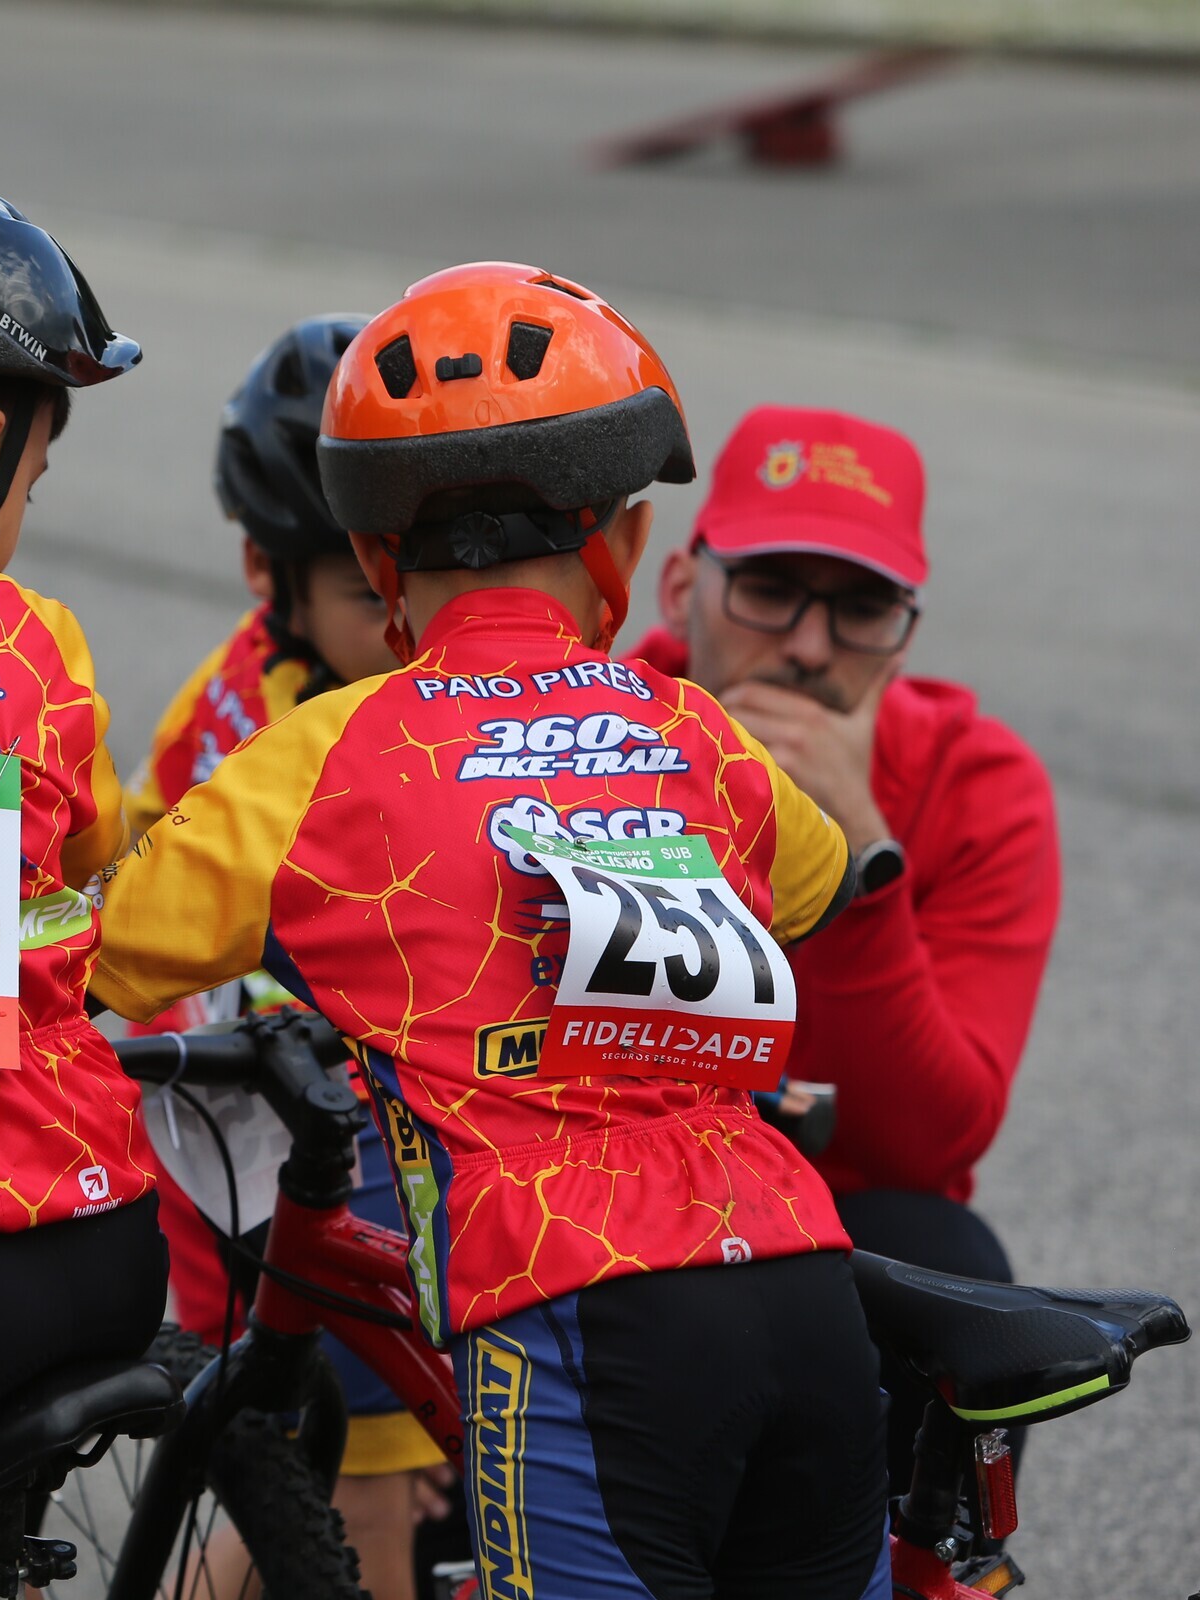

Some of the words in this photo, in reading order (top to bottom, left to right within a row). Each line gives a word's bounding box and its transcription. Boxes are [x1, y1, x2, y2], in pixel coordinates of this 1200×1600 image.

[414, 675, 523, 700] PAIO
[532, 660, 653, 701] PIRES
[456, 746, 690, 782] BIKE-TRAIL
[570, 851, 654, 871] CICLISMO
[660, 846, 693, 860] SUB
[678, 863, 689, 875] 9
[19, 892, 87, 942] MPA
[572, 867, 775, 1005] 251
[562, 1020, 775, 1064] FIDELIDADE
[602, 1052, 650, 1062] SEGUROS
[692, 1061, 719, 1071] 1808
